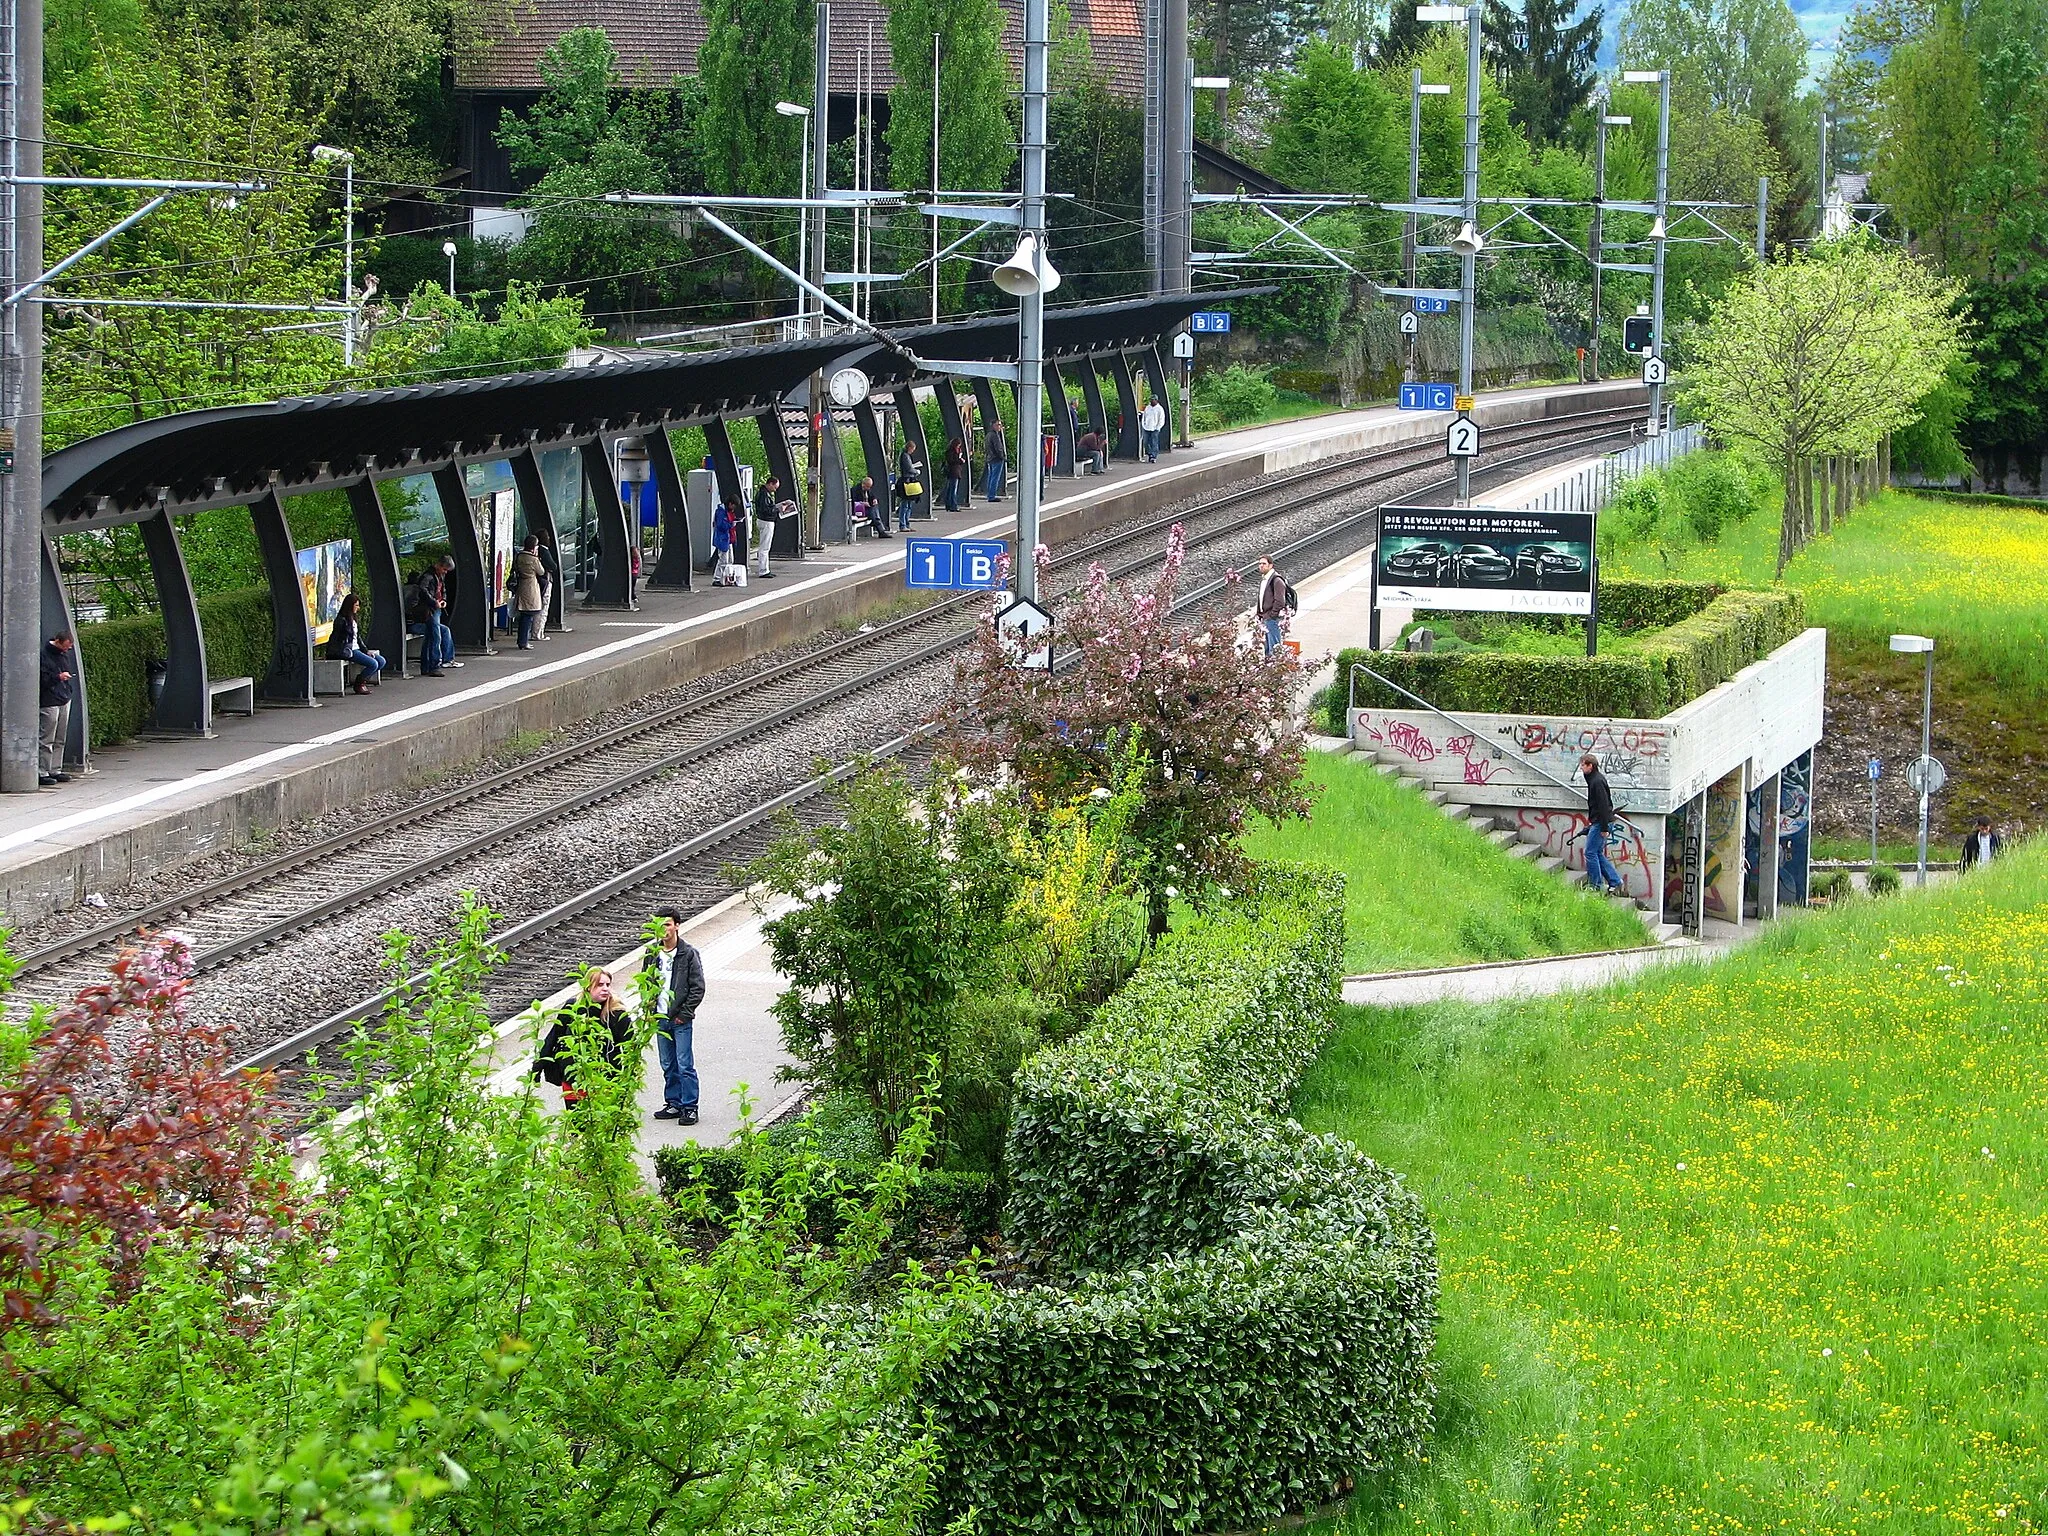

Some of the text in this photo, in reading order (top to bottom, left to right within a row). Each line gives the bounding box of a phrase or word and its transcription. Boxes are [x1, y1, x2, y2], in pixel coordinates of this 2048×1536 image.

[1419, 301, 1428, 309] C
[1435, 301, 1442, 310] 2
[1197, 319, 1205, 329] B
[1216, 319, 1224, 329] 2
[1405, 317, 1412, 330] 2
[1181, 339, 1186, 354] 1
[1650, 364, 1659, 379] 3
[1409, 392, 1415, 405] 1
[1434, 392, 1446, 406] C
[1457, 428, 1469, 451] 2
[1384, 516, 1543, 528] DIE REVOLUTION DER MOTOREN.
[925, 555, 936, 580] 1
[971, 556, 992, 581] B
[1510, 595, 1585, 607] JAGUAR
